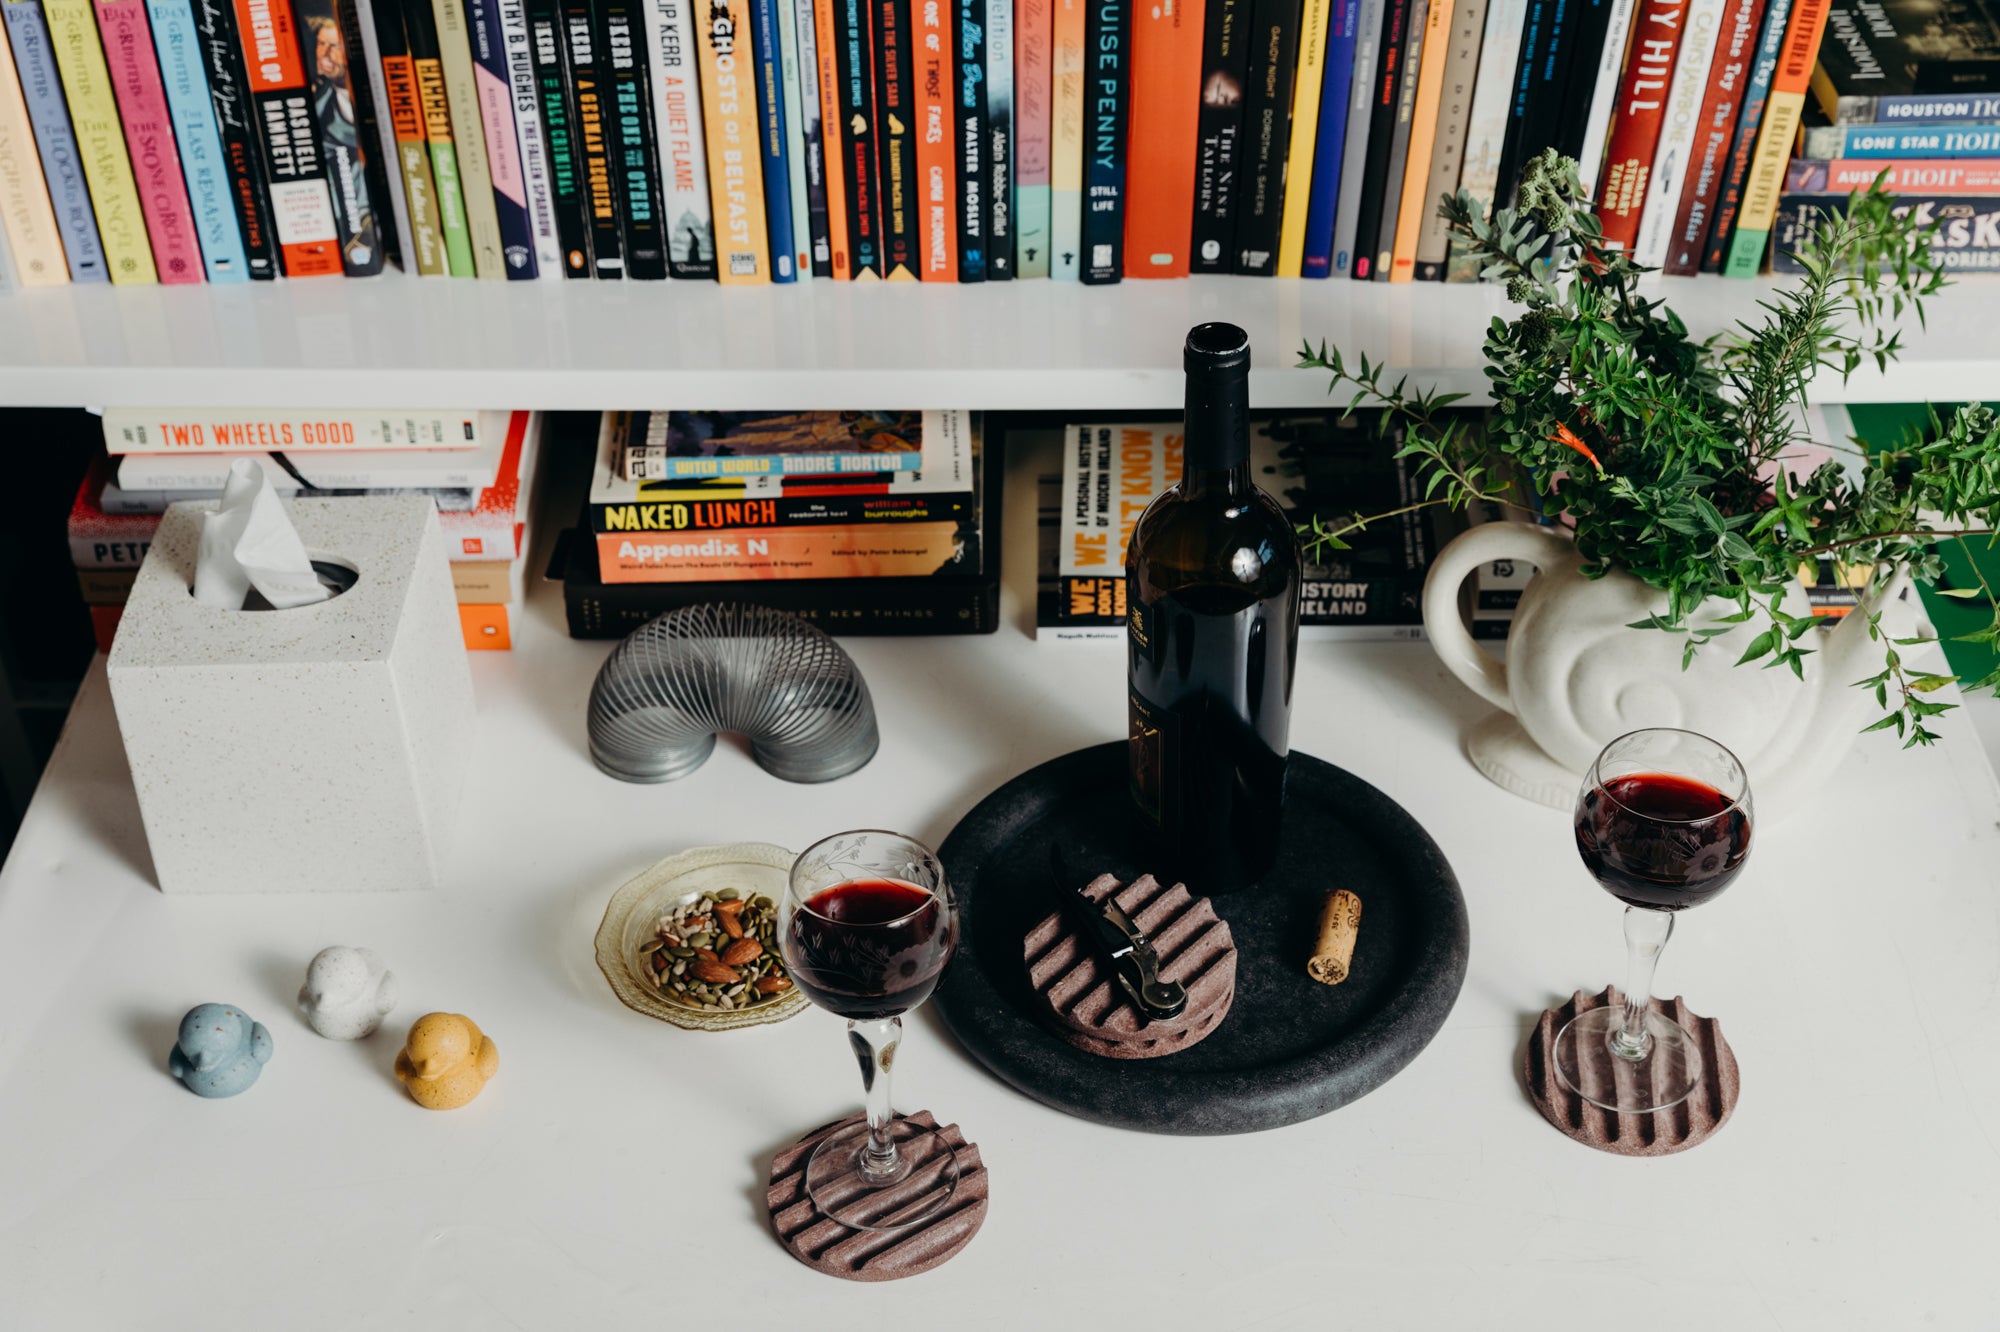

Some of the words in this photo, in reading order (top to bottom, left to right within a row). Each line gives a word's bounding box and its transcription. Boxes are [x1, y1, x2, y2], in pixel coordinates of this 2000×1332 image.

[883, 1, 896, 28] WITH
[923, 1, 940, 29] ONE
[508, 34, 526, 49] B.
[535, 28, 557, 65] KERR
[570, 24, 593, 65] KERR
[609, 25, 634, 69] KERR
[660, 24, 682, 67] KERR
[849, 40, 862, 78] SENSITIVE
[884, 30, 897, 47] THE
[925, 33, 941, 52] OF
[118, 22, 142, 97] GRIFFITHS
[260, 63, 283, 83] OP
[712, 17, 740, 116] GHOSTS
[885, 49, 898, 81] SILVER
[925, 59, 942, 100] THOSE
[1629, 40, 1673, 116] HILL
[1718, 62, 1743, 91] Tey
[1754, 58, 1777, 88] Tey
[387, 61, 418, 136] HAMMETT
[421, 65, 451, 138] HAMMETT
[511, 51, 536, 112] HUGHES
[577, 79, 596, 90] A
[616, 81, 638, 113] THE
[665, 76, 683, 87] A
[851, 78, 863, 107] CRIMES
[886, 82, 900, 108] SAAB
[1265, 64, 1278, 99] NIGHT
[546, 92, 566, 126] PALE
[579, 93, 605, 152] GERMAN
[665, 91, 690, 136] QUIET
[926, 105, 944, 144] FACES
[1095, 79, 1118, 170] PENNY
[1669, 65, 1699, 143] JAWBONE
[1712, 101, 1732, 127] The
[1886, 103, 1969, 117] HOUSTON
[263, 100, 297, 176] HAMMETT
[286, 97, 319, 175] DASHIELL
[523, 120, 538, 140] THE
[620, 116, 642, 145] ONE
[725, 120, 741, 145] OF
[965, 116, 979, 174] WALTER
[1220, 125, 1237, 164] THE
[1259, 108, 1275, 161] DOROTHY
[1765, 105, 1792, 159] HARLEM
[1852, 136, 1896, 150] LONE
[1899, 135, 1940, 150] STAR
[92, 136, 117, 186] DARK
[526, 141, 543, 180] FALLEN
[551, 128, 575, 196] CRIMINAL
[671, 140, 695, 193] FLAME
[1201, 134, 1220, 212] TAILORS
[1695, 131, 1725, 197] Franchise
[1731, 127, 1757, 186] Daughter
[138, 135, 167, 187] STONE
[153, 193, 183, 250] CIRCLE
[588, 157, 613, 218] REQUIEM
[627, 171, 651, 221] OTHER
[723, 149, 750, 245] BELFAST
[1090, 186, 1118, 197] STILL
[1215, 170, 1234, 218] NINE
[1253, 174, 1268, 217] SAYERS
[1603, 163, 1625, 210] TAYLOR
[1616, 158, 1640, 217] STEWART
[1631, 166, 1650, 209] SARAH
[1750, 164, 1777, 216] SHUFFLE
[1900, 168, 1965, 187] noir
[197, 167, 224, 245] REMAINS
[237, 177, 262, 248] GRIFFITHS
[533, 183, 551, 237] SPARROW
[859, 213, 871, 237] SMITH
[893, 210, 905, 235] SMITH
[966, 180, 980, 238] MOSLEY
[1092, 200, 1115, 212] LIFE
[1685, 201, 1708, 244] Affair
[1718, 206, 1737, 239] Time
[69, 206, 94, 256] ROOM
[160, 424, 205, 446] TWO
[212, 422, 294, 446] WHEELS
[302, 421, 355, 445] GOOD
[1078, 426, 1093, 469] HISTORY
[1097, 428, 1113, 471] IRELAND
[675, 460, 718, 475] WITCH
[721, 458, 771, 474] WORLD
[1120, 428, 1154, 496] KNOW
[864, 508, 930, 519] burroughs
[1076, 470, 1092, 519] PERSONAL
[1096, 472, 1111, 514] MODERN
[604, 503, 689, 531] NAKED
[693, 500, 777, 528] LUNCH
[1096, 515, 1110, 527] OF
[617, 538, 741, 563] Appendix
[747, 539, 769, 556] N
[1073, 531, 1108, 567] WE
[1070, 578, 1097, 616] WE
[1097, 578, 1113, 616] DON'T
[1301, 582, 1369, 599] ISTORY
